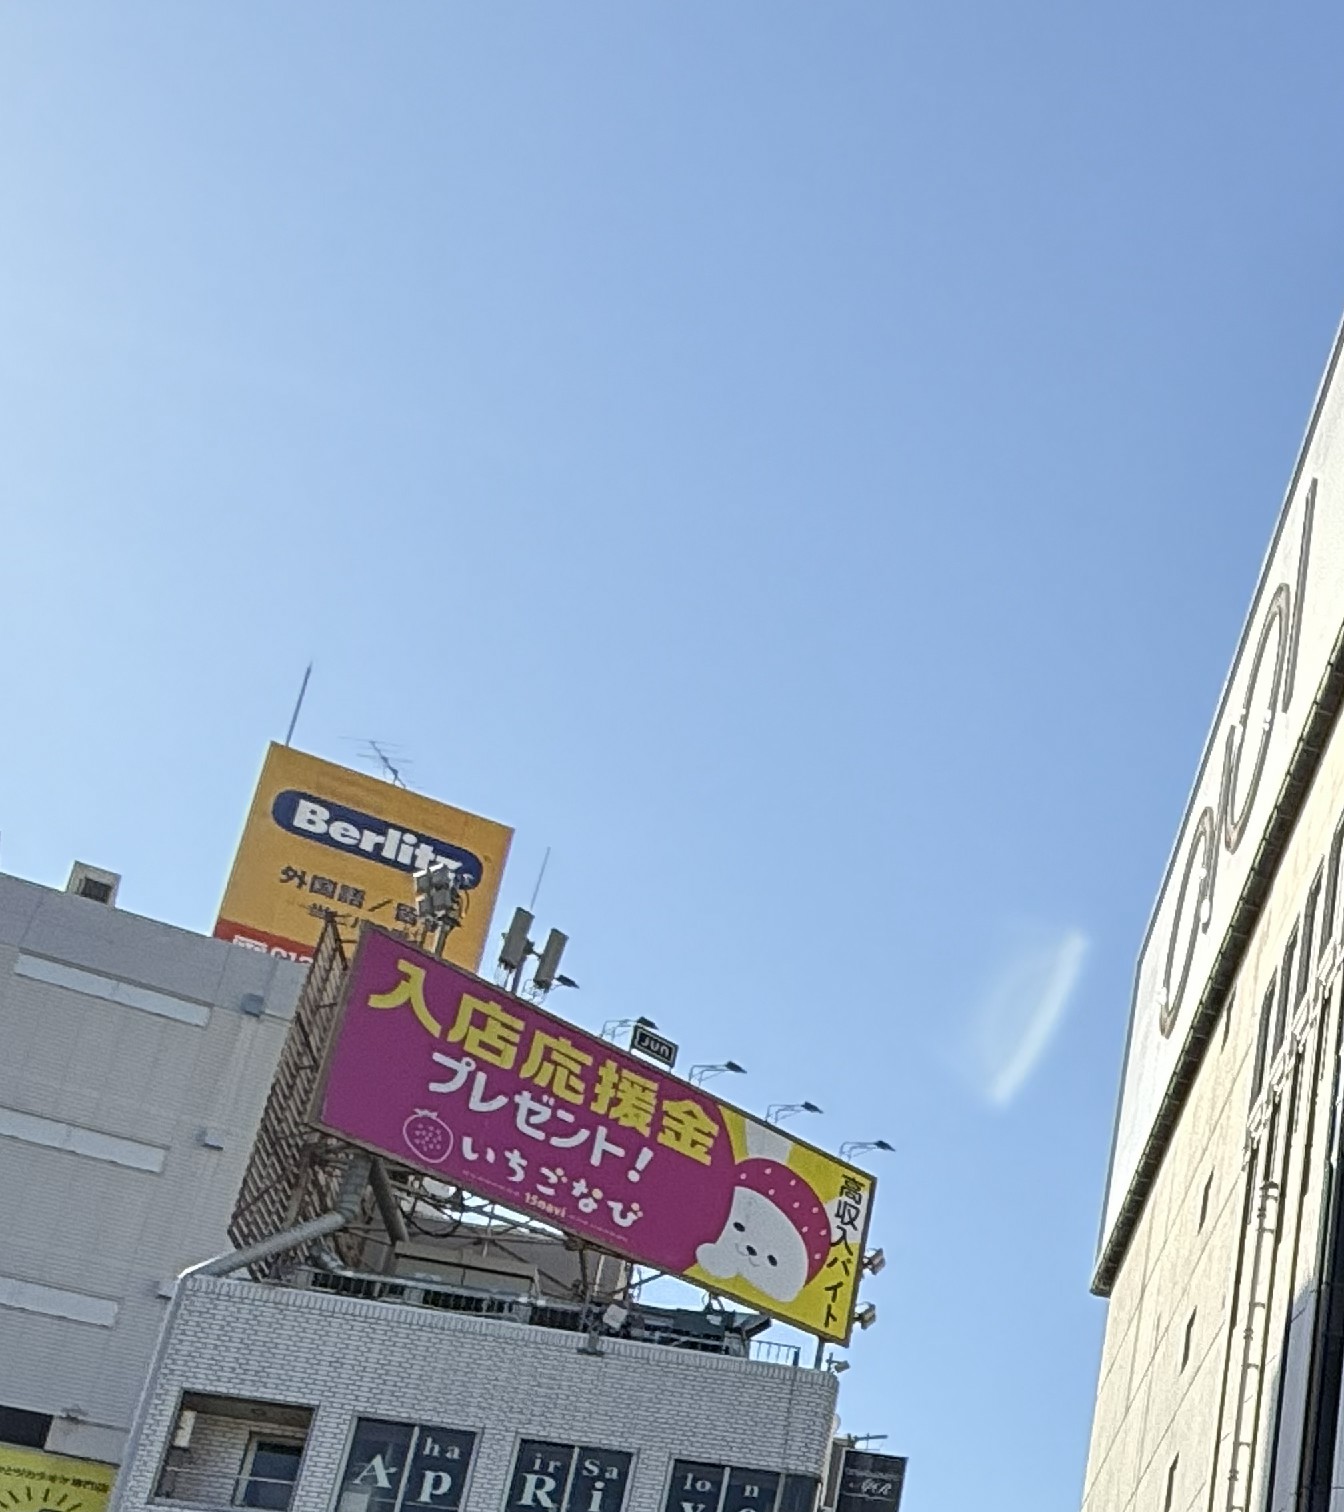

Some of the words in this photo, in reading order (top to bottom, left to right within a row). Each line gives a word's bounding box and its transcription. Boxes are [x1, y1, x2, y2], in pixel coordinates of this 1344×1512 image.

[369, 958, 720, 1166] 入店応援金
[460, 1135, 643, 1229] いちごなび
[822, 1173, 866, 1330] 高収入バイト
